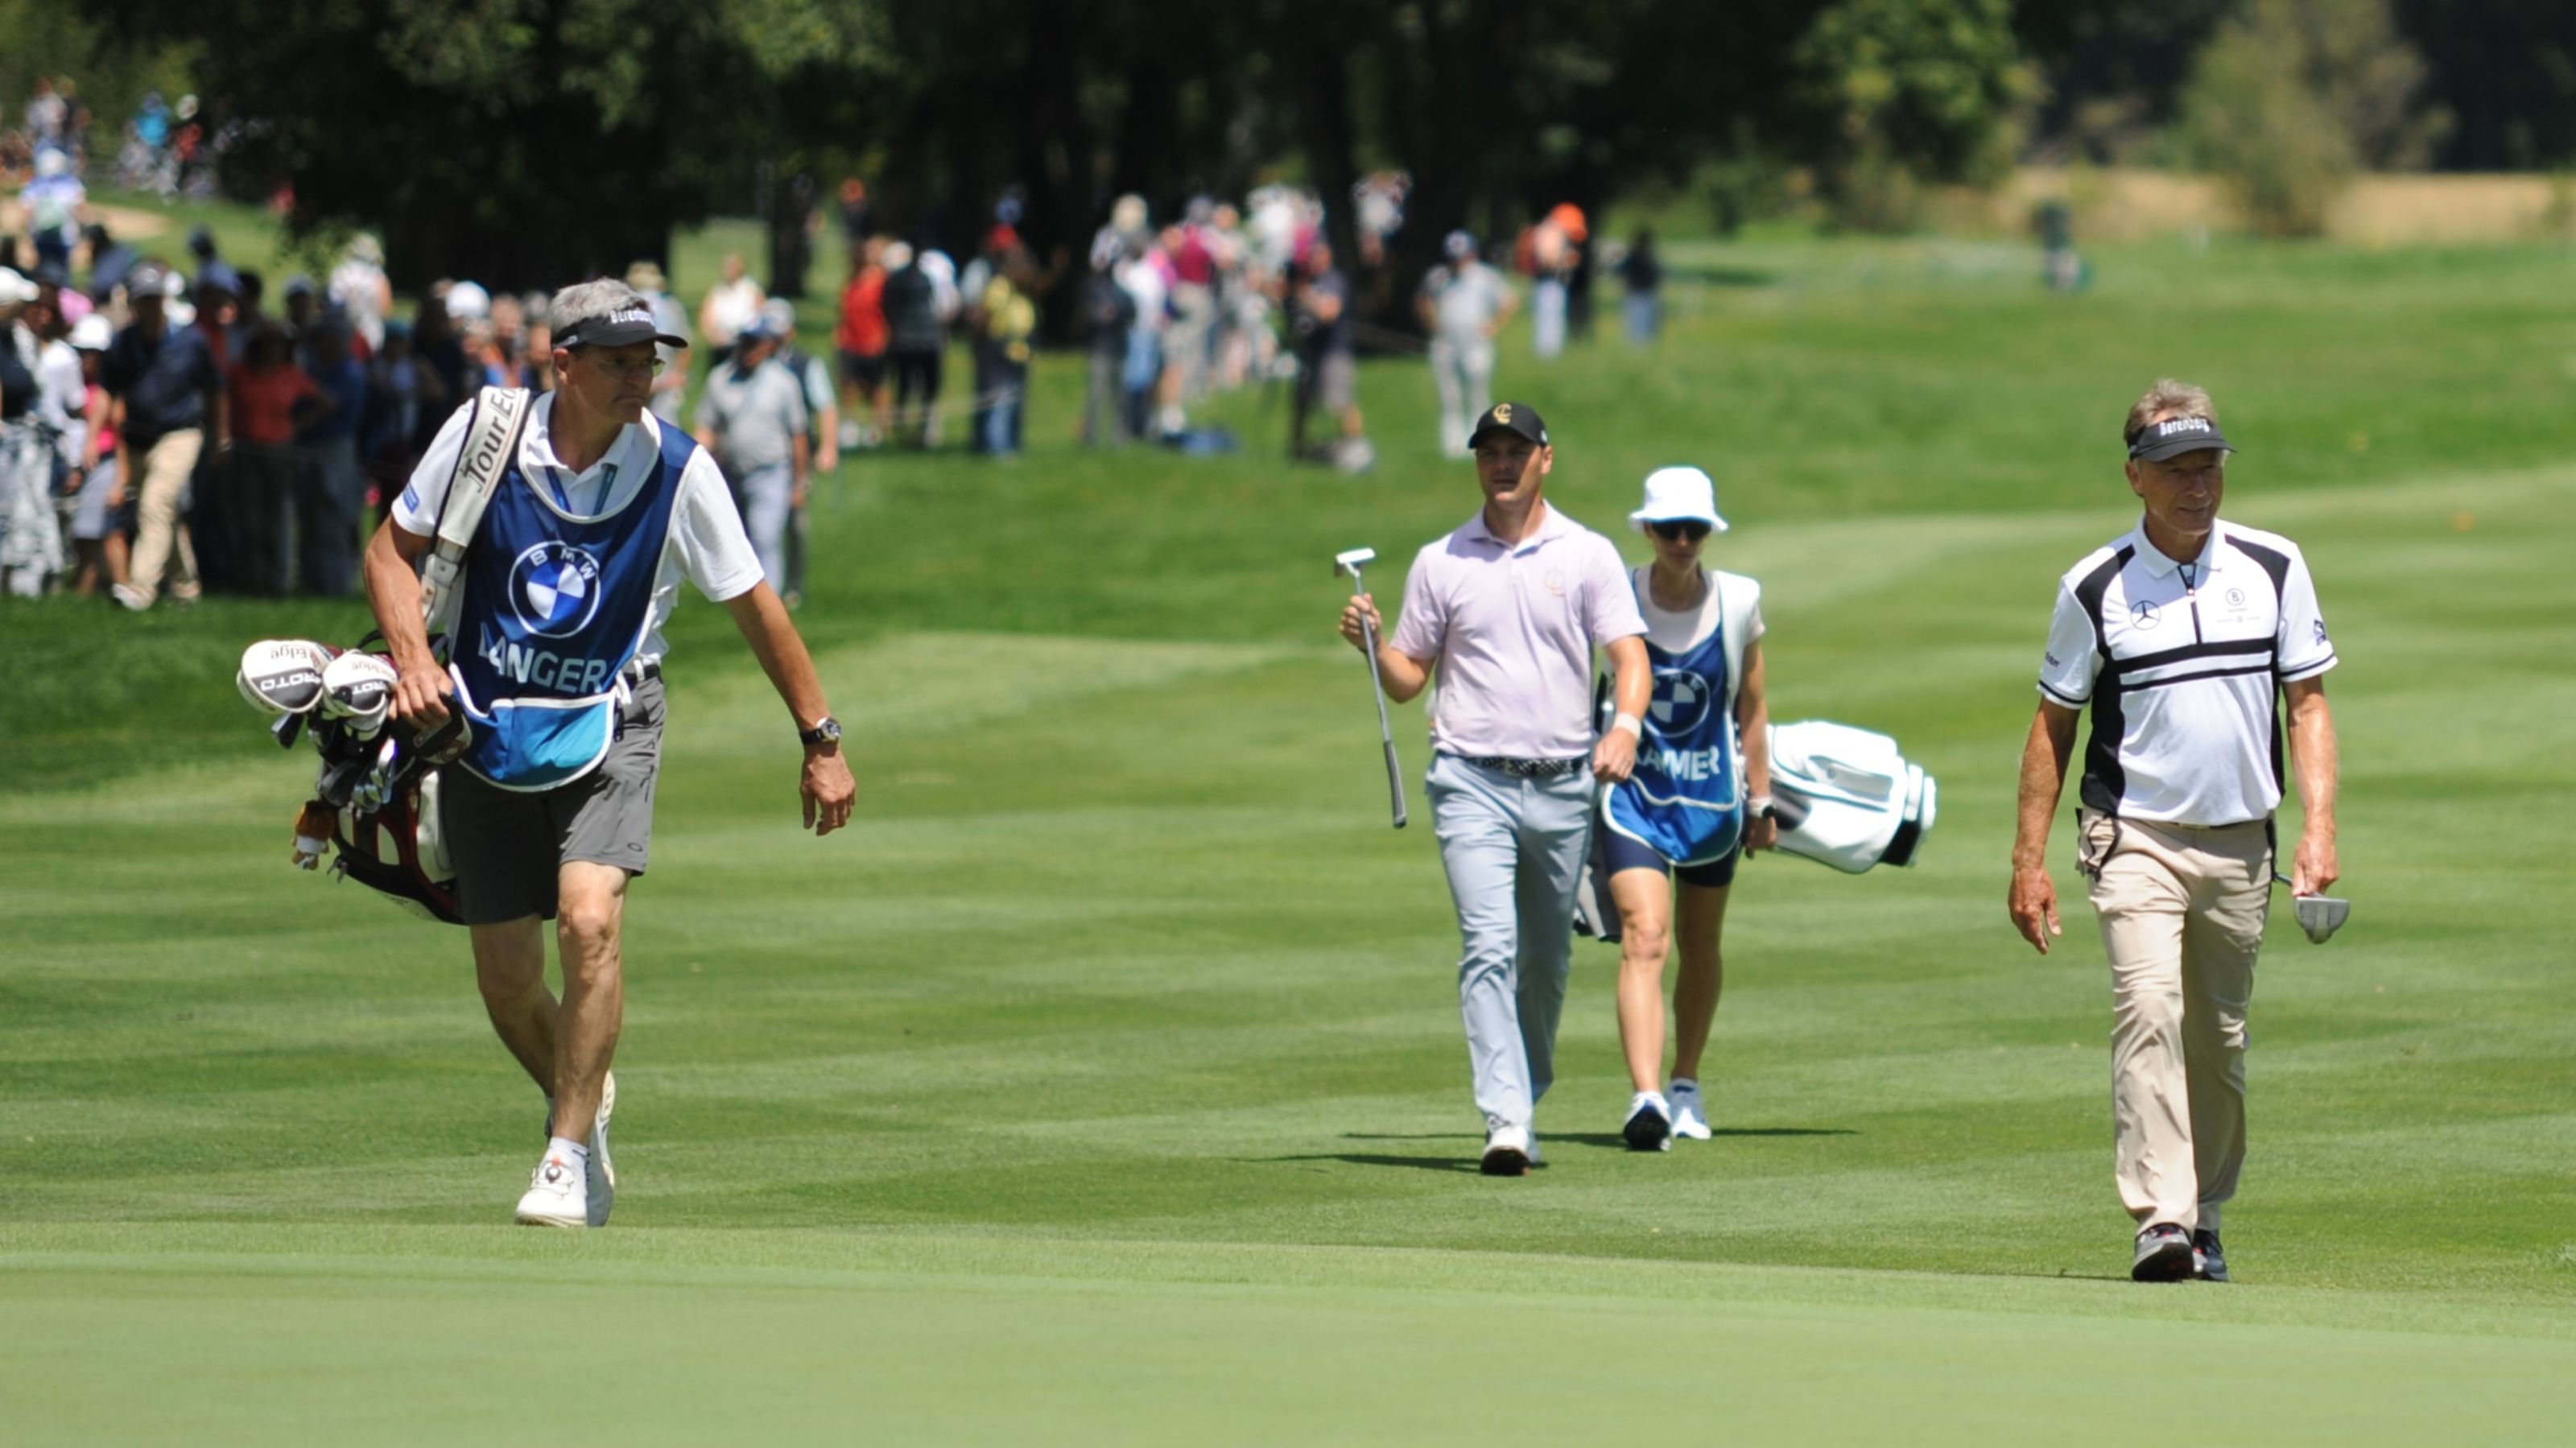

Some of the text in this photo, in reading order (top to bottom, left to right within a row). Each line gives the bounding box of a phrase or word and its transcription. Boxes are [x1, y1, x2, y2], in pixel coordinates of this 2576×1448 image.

[460, 416, 506, 485] Tour
[530, 547, 596, 580] BMW
[270, 645, 308, 660] Edge
[477, 622, 607, 694] LANGER
[1637, 744, 1721, 782] AMER
